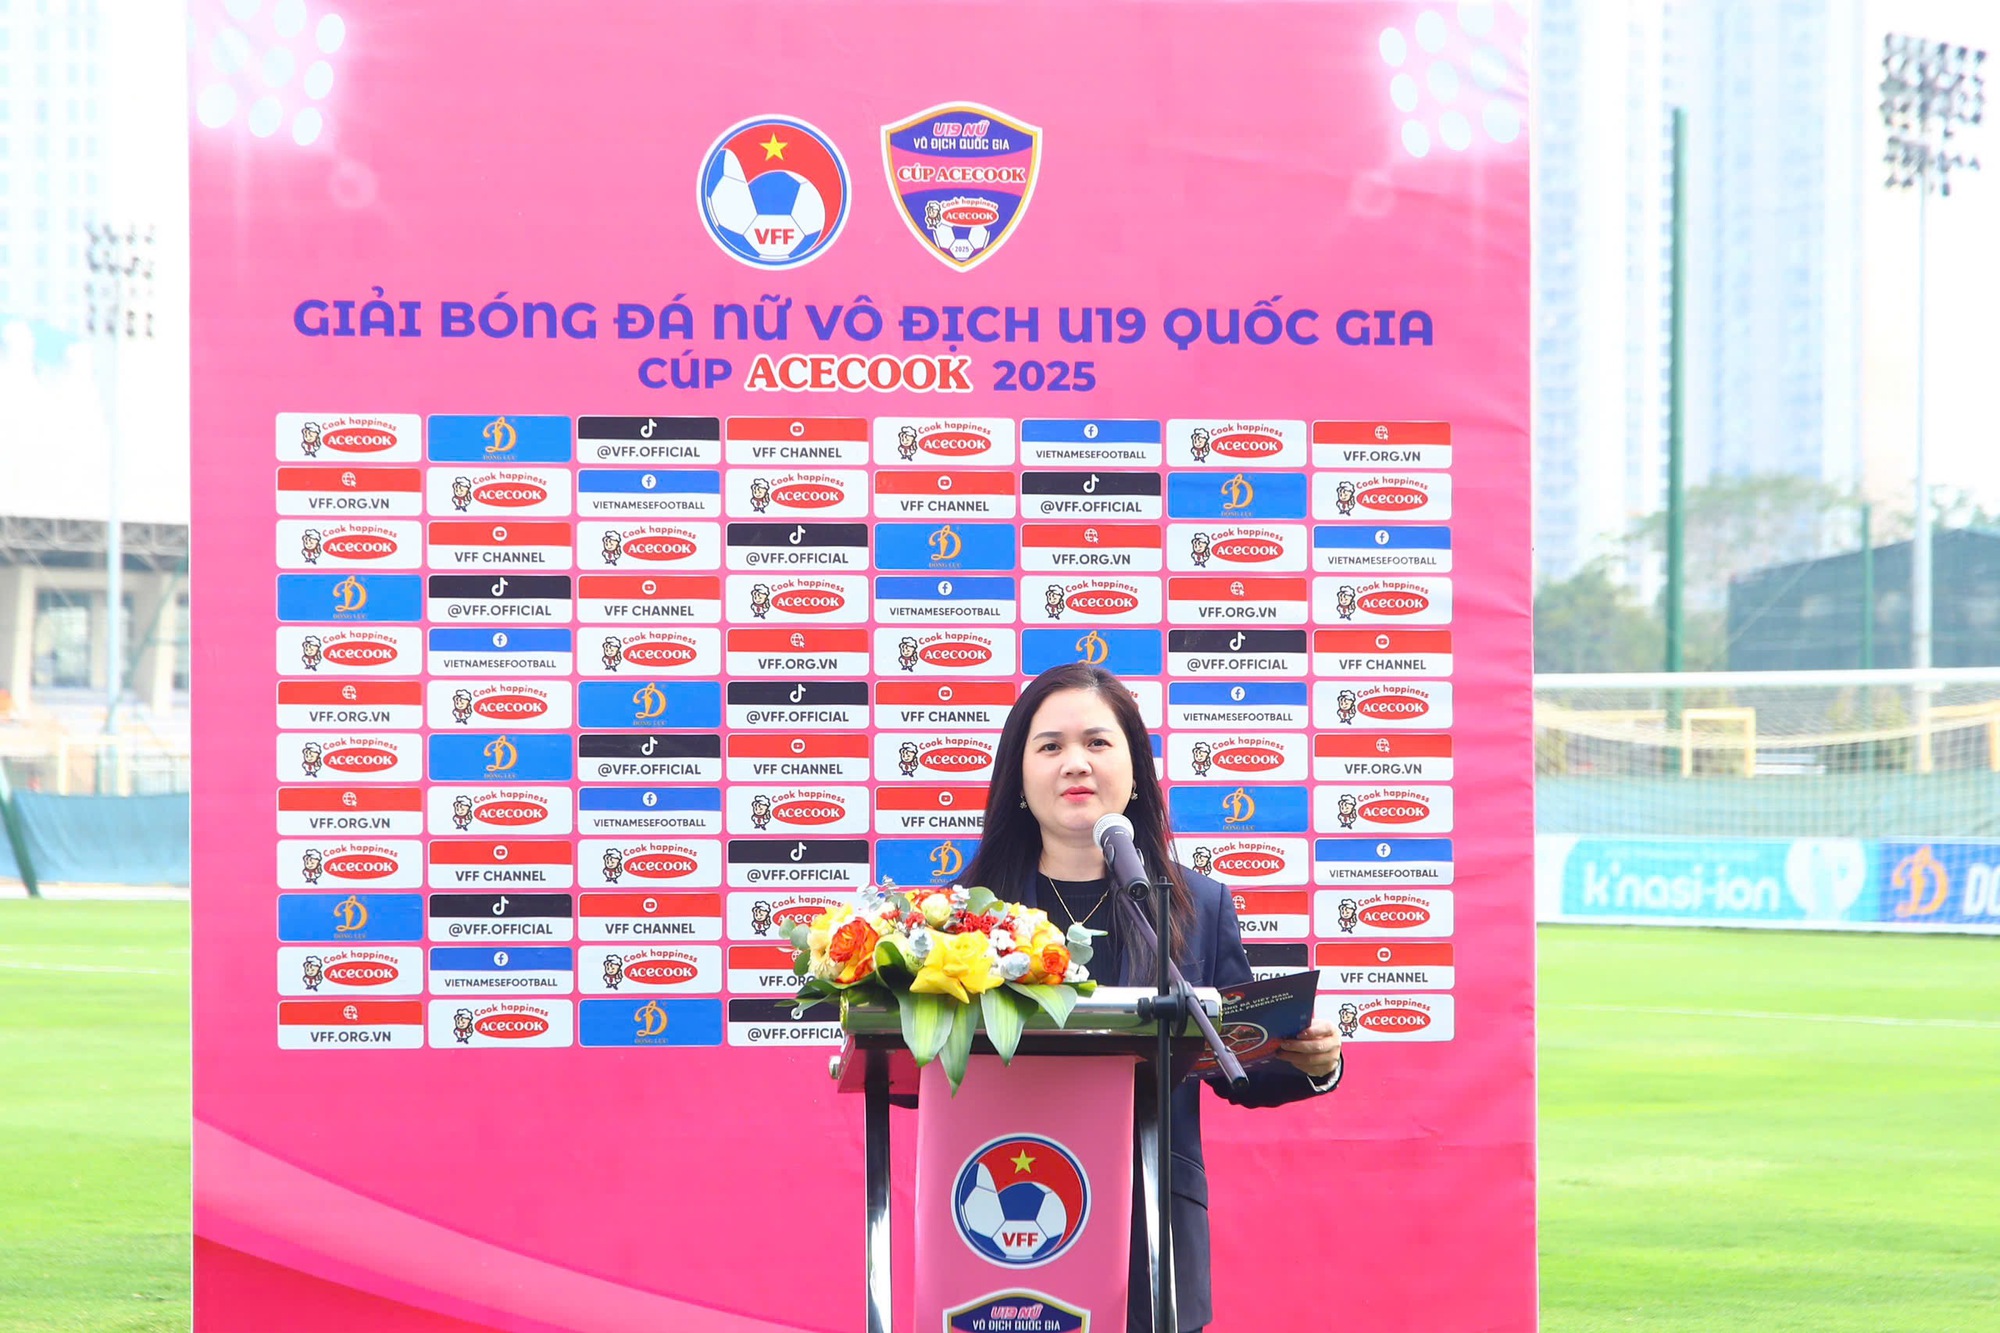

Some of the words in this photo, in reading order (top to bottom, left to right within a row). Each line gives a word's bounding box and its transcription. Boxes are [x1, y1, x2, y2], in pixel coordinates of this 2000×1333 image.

[933, 122, 962, 136] U19
[914, 137, 928, 149] VÔ
[992, 139, 1010, 150] GIA
[898, 164, 934, 182] CÚP
[938, 168, 1025, 182] ACECOOK
[942, 200, 960, 208] Cook
[961, 198, 998, 210] happiness
[754, 228, 794, 246] VFF
[294, 286, 422, 337] GIẢI
[614, 293, 694, 340] ĐÁ
[804, 294, 884, 342] VÔ
[898, 305, 1039, 352] ĐỊCH
[1058, 306, 1146, 344] U19
[1164, 295, 1320, 350] QUỐC
[1336, 309, 1434, 346] GIA
[638, 350, 732, 389] CÚP
[746, 355, 972, 392] ACECOOK
[993, 360, 1096, 392] 2025
[322, 418, 346, 430] Cook
[348, 417, 396, 431] happiness
[918, 422, 942, 434] Cook
[944, 421, 991, 435] happiness
[1211, 424, 1234, 435] Cook
[1236, 422, 1283, 436] happiness
[596, 446, 700, 460] @VFF.OFFICIAL
[752, 446, 776, 458] VFF
[780, 446, 842, 458] CHANNEL
[1036, 450, 1146, 458] VIETNAMESEFOOTBALL
[1344, 450, 1420, 462] VFF.ORG.VN
[771, 474, 795, 486] Cook
[797, 473, 844, 487] happiness
[1356, 476, 1379, 488] Cook
[1381, 475, 1428, 489] happiness
[308, 498, 390, 508] VFF.ORG.VN
[592, 500, 704, 510] VIETNAMESEFOOTBALL
[900, 500, 924, 512] VFF
[928, 500, 990, 512] CHANNEL
[1040, 500, 1142, 514] @VFF.OFFICIAL
[322, 524, 346, 536] Cook
[348, 523, 398, 537] happiness
[454, 552, 478, 562] VFF
[482, 552, 546, 562] CHANNEL
[746, 552, 848, 566] @VFF.OFFICIAL
[1052, 554, 1130, 564] VFF.ORG.VN
[1328, 556, 1436, 564] VIETNAMESEFOOTBALL
[1065, 580, 1088, 592] Cook
[1090, 579, 1137, 593] happiness
[1357, 582, 1380, 593] Cook
[1382, 580, 1428, 594] happiness
[448, 604, 552, 618] @VFF.OFFICIAL
[604, 606, 628, 616] VFF
[632, 606, 694, 616] CHANNEL
[890, 608, 1000, 616] VIETNAMESEFOOTBALL
[1198, 606, 1276, 618] VFF.ORG.VN
[919, 632, 942, 644] Cook
[944, 631, 991, 645] happiness
[444, 660, 556, 668] VIETNAMESEFOOTBALL
[758, 658, 838, 670] VFF.ORG.VN
[1186, 658, 1288, 672] @VFF.OFFICIAL
[1338, 660, 1362, 670] VFF
[1366, 660, 1426, 670] CHANNEL
[473, 686, 497, 697] Cook
[499, 684, 548, 698] happiness
[310, 712, 390, 722] VFF.ORG.VN
[746, 710, 850, 724] @VFF.OFFICIAL
[901, 712, 926, 722] VFF
[928, 712, 990, 722] CHANNEL
[1184, 712, 1292, 722] VIETNAMESEFOOTBALL
[1212, 738, 1235, 749] Cook
[1237, 736, 1284, 750] happiness
[598, 764, 702, 778] @VFF.OFFICIAL
[754, 764, 778, 774] VFF
[780, 764, 844, 774] CHANNEL
[1344, 764, 1422, 774] VFF.ORG.VN
[772, 790, 796, 802] Cook
[798, 789, 845, 803] happiness
[310, 818, 390, 828] VFF.ORG.VN
[594, 818, 706, 828] VIETNAMESEFOOTBALL
[902, 816, 925, 827] VFF
[928, 816, 984, 827] CHANNE
[1213, 842, 1236, 854] Cook
[1238, 841, 1284, 855] happiness
[456, 870, 480, 882] VFF
[484, 870, 546, 882] CHANNEL
[746, 868, 850, 882] @VFF.OFFICIAL
[1330, 870, 1438, 878] VIETNAMESEFOOTBALL
[772, 896, 796, 908] Cook
[798, 896, 844, 908] happines
[1358, 894, 1381, 906] Cook
[1383, 893, 1430, 907] happiness
[448, 924, 552, 938] @VFF.OFFICIAL
[604, 922, 630, 934] VFF
[632, 922, 696, 934] CHANNEL
[324, 952, 348, 963] Cook
[350, 950, 398, 964] happiness
[444, 978, 558, 986] VIETNAMESEFOOTBALL
[1340, 972, 1364, 984] VFF
[1368, 972, 1428, 984] CHANNEL
[474, 1004, 498, 1016] Cook
[500, 1003, 548, 1017] happiness
[1358, 998, 1381, 1010] Cook
[1383, 997, 1430, 1011] happiness
[310, 1032, 392, 1042] VFF.ORG.VN
[748, 1028, 844, 1041] @VFF.OFFICIA
[1002, 1232, 1038, 1247] VFF
